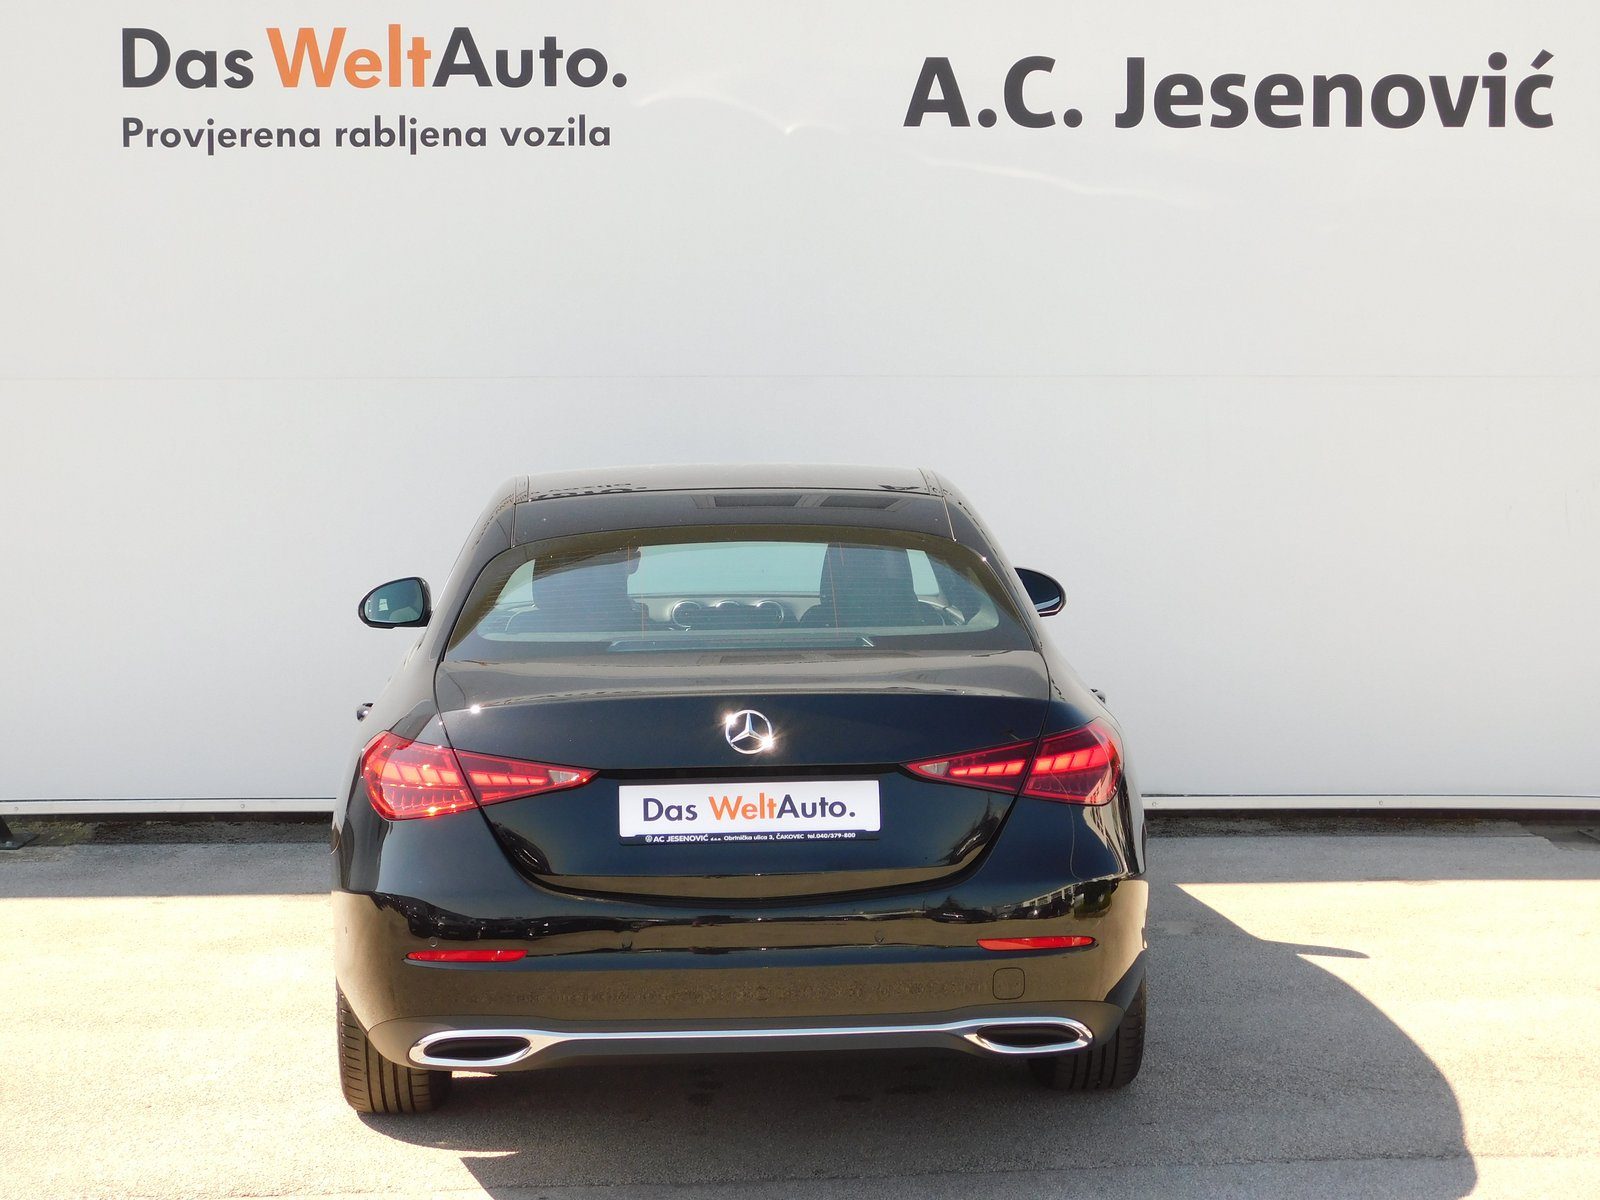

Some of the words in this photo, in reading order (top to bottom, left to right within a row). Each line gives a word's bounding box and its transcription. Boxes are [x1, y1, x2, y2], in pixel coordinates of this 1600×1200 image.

[121, 27, 255, 89] Das
[265, 23, 628, 89] WeltAuto.
[903, 55, 1083, 129] A.C.
[1114, 49, 1554, 129] Jesenović
[122, 117, 321, 156] Provjerena
[335, 114, 487, 156] rabljena
[500, 114, 611, 147] vozila
[643, 797, 698, 822] Das
[708, 792, 856, 821] WeltAuto.
[653, 835, 665, 843] AC
[666, 833, 709, 843] JESENOVIĆ
[776, 832, 805, 840] ČAKOVEC
